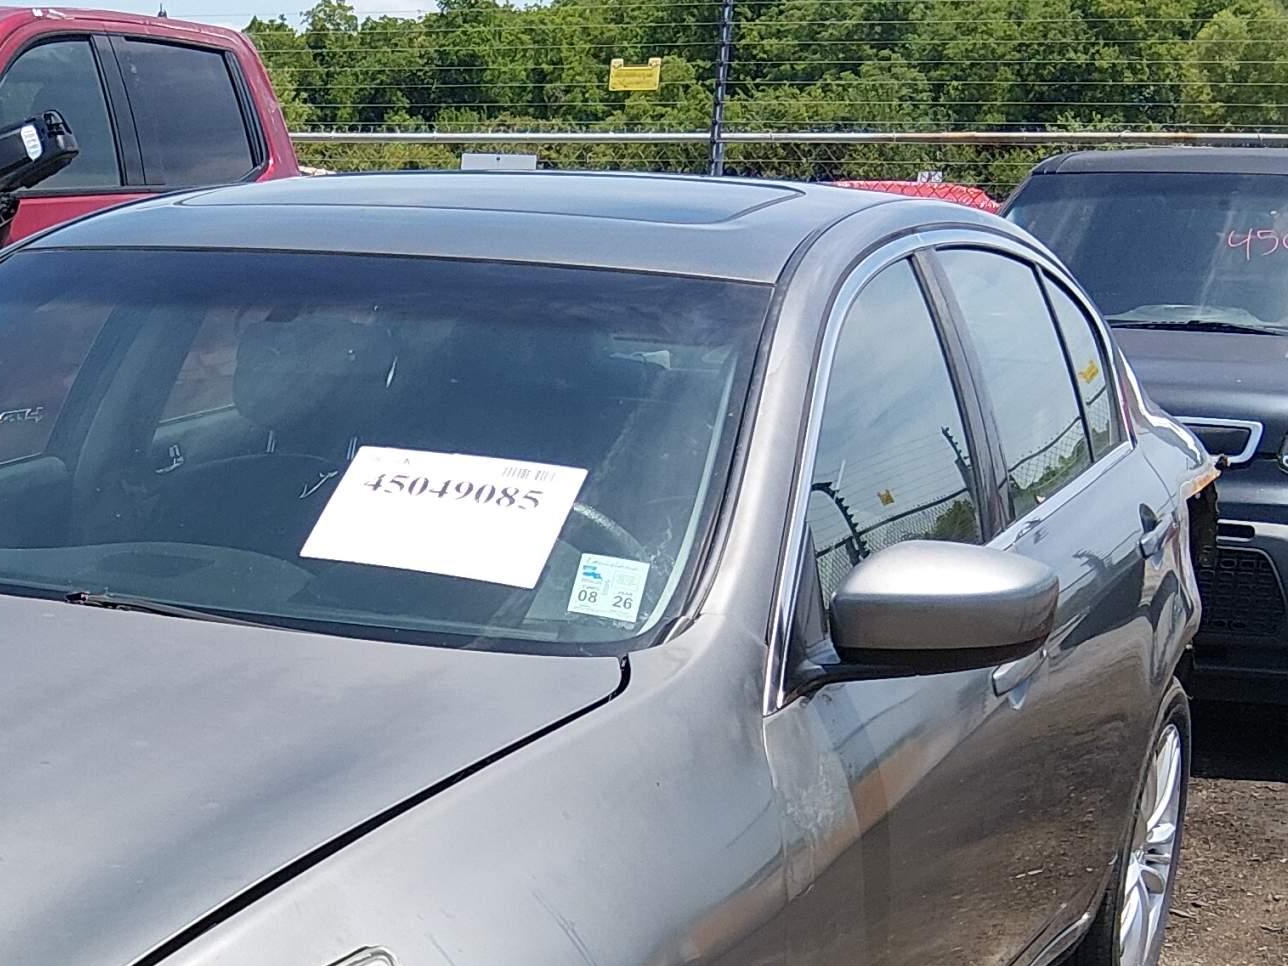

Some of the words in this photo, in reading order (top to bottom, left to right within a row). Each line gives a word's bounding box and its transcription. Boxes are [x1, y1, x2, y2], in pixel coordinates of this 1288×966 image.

[363, 473, 544, 510] 45049085
[577, 589, 598, 603] 08
[612, 595, 633, 609] 26
